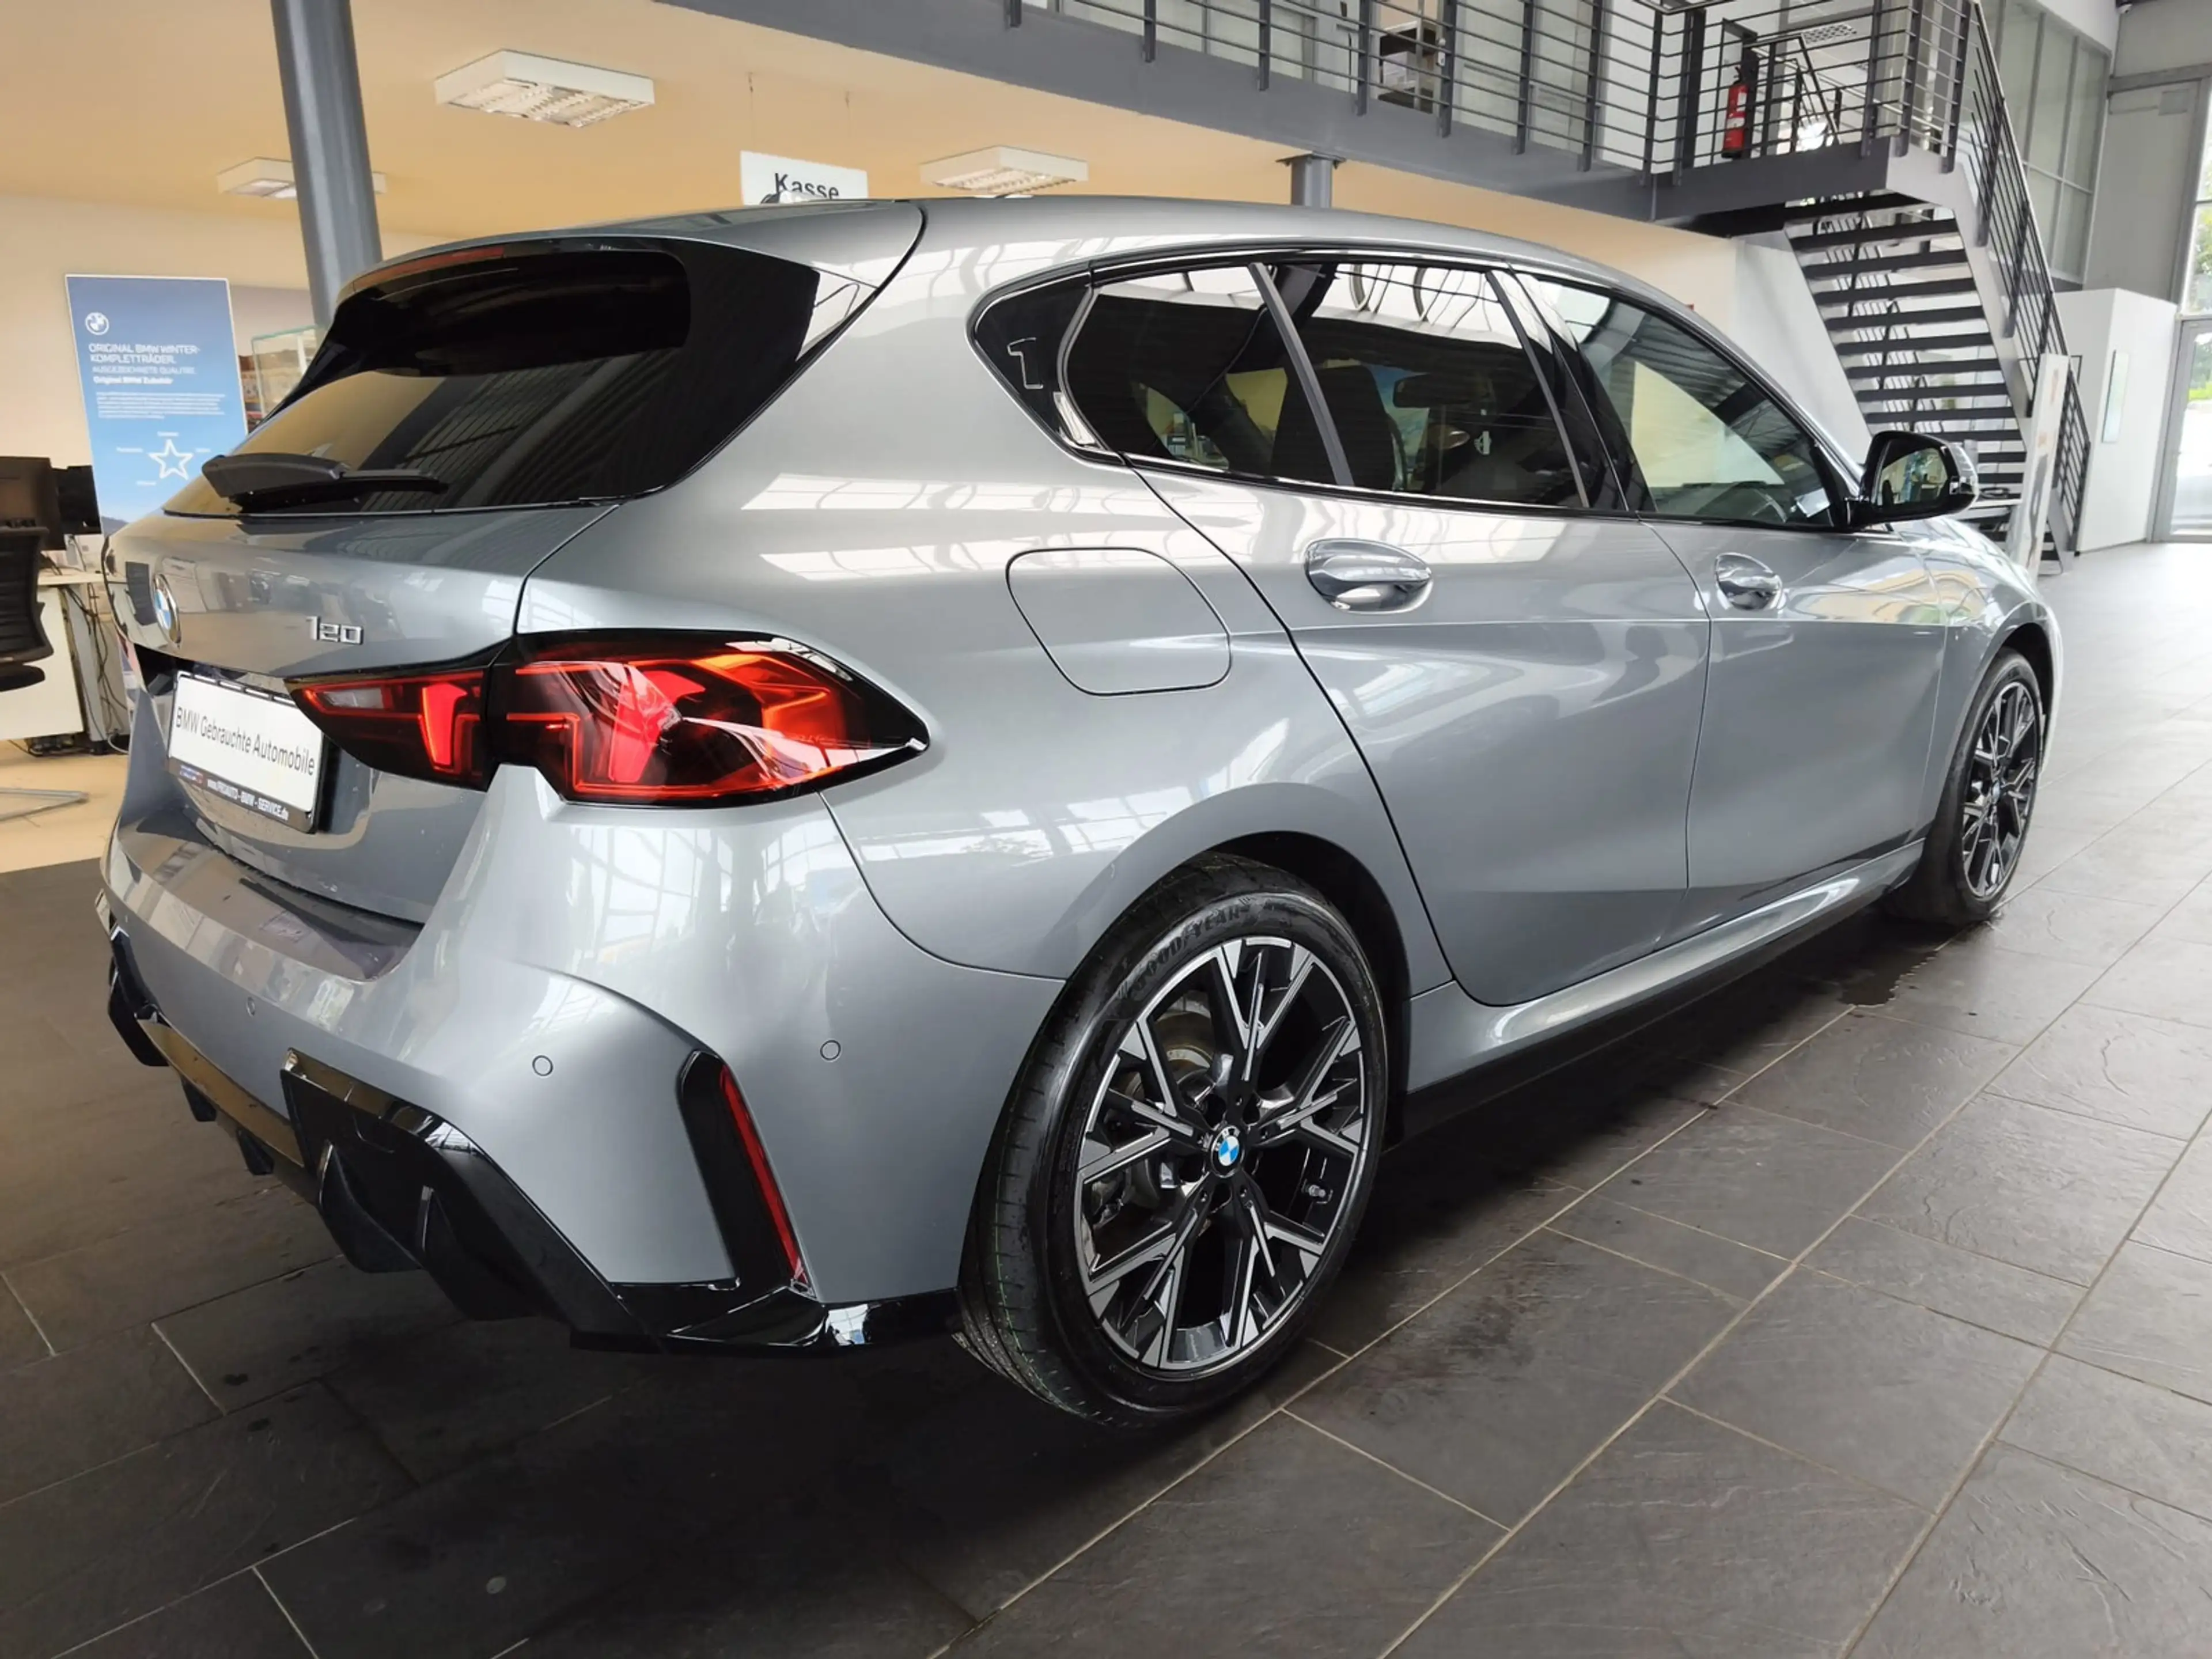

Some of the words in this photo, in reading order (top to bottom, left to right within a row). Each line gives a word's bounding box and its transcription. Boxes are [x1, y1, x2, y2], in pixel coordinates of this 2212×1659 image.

[774, 173, 839, 199] Kasse
[88, 343, 134, 353] ORIGINAL
[135, 344, 160, 354] BMW
[306, 616, 364, 646] 120
[176, 707, 199, 734] BMW
[200, 715, 251, 753] Gebrauchte
[252, 734, 315, 776] Automobile
